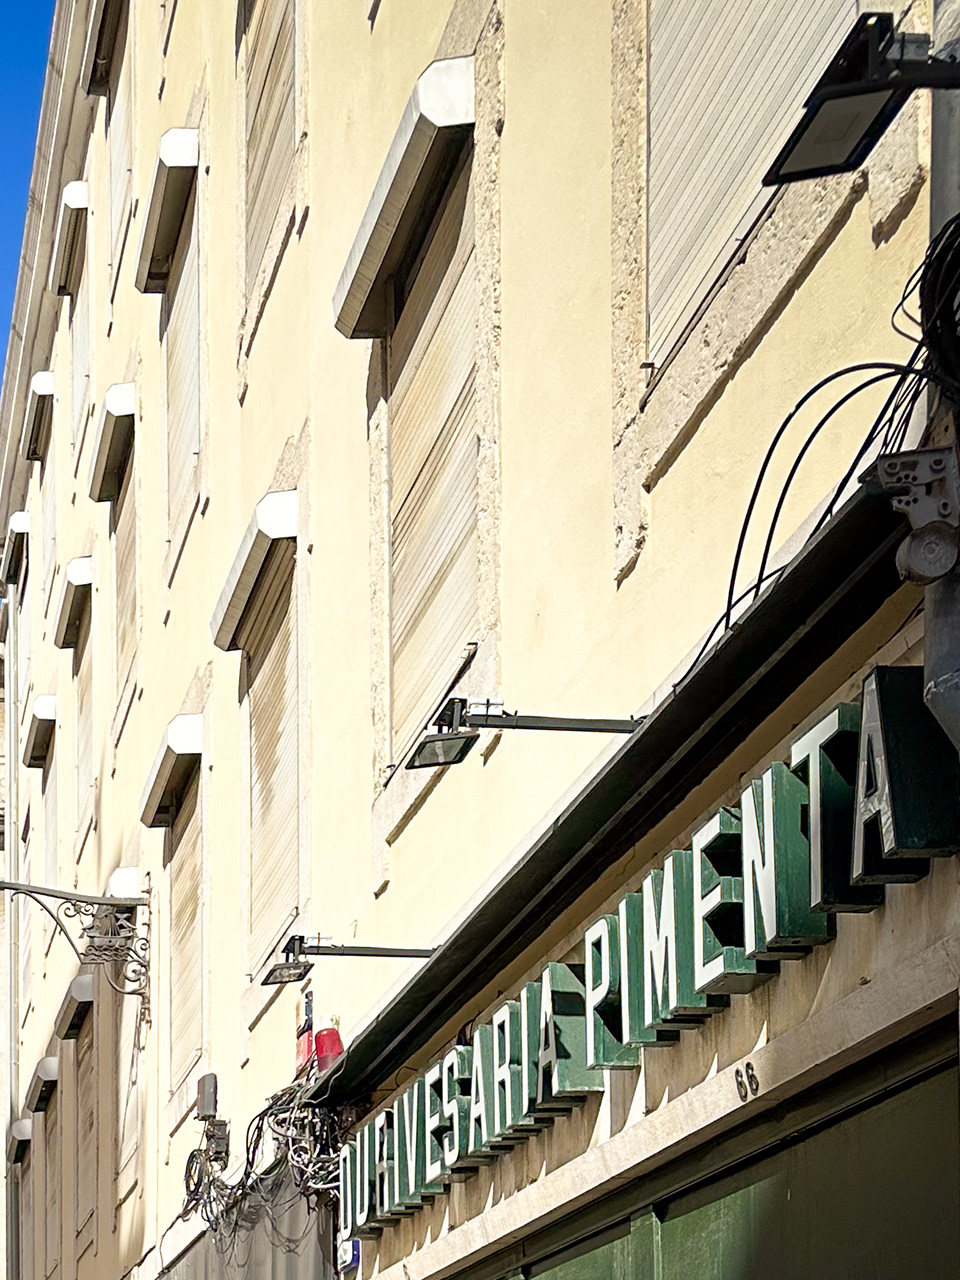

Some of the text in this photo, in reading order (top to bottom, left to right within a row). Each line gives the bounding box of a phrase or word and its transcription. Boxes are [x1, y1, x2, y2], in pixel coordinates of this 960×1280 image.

[339, 674, 899, 1241] OURIVESARIA PIMENTA
[734, 1061, 759, 1103] 66
